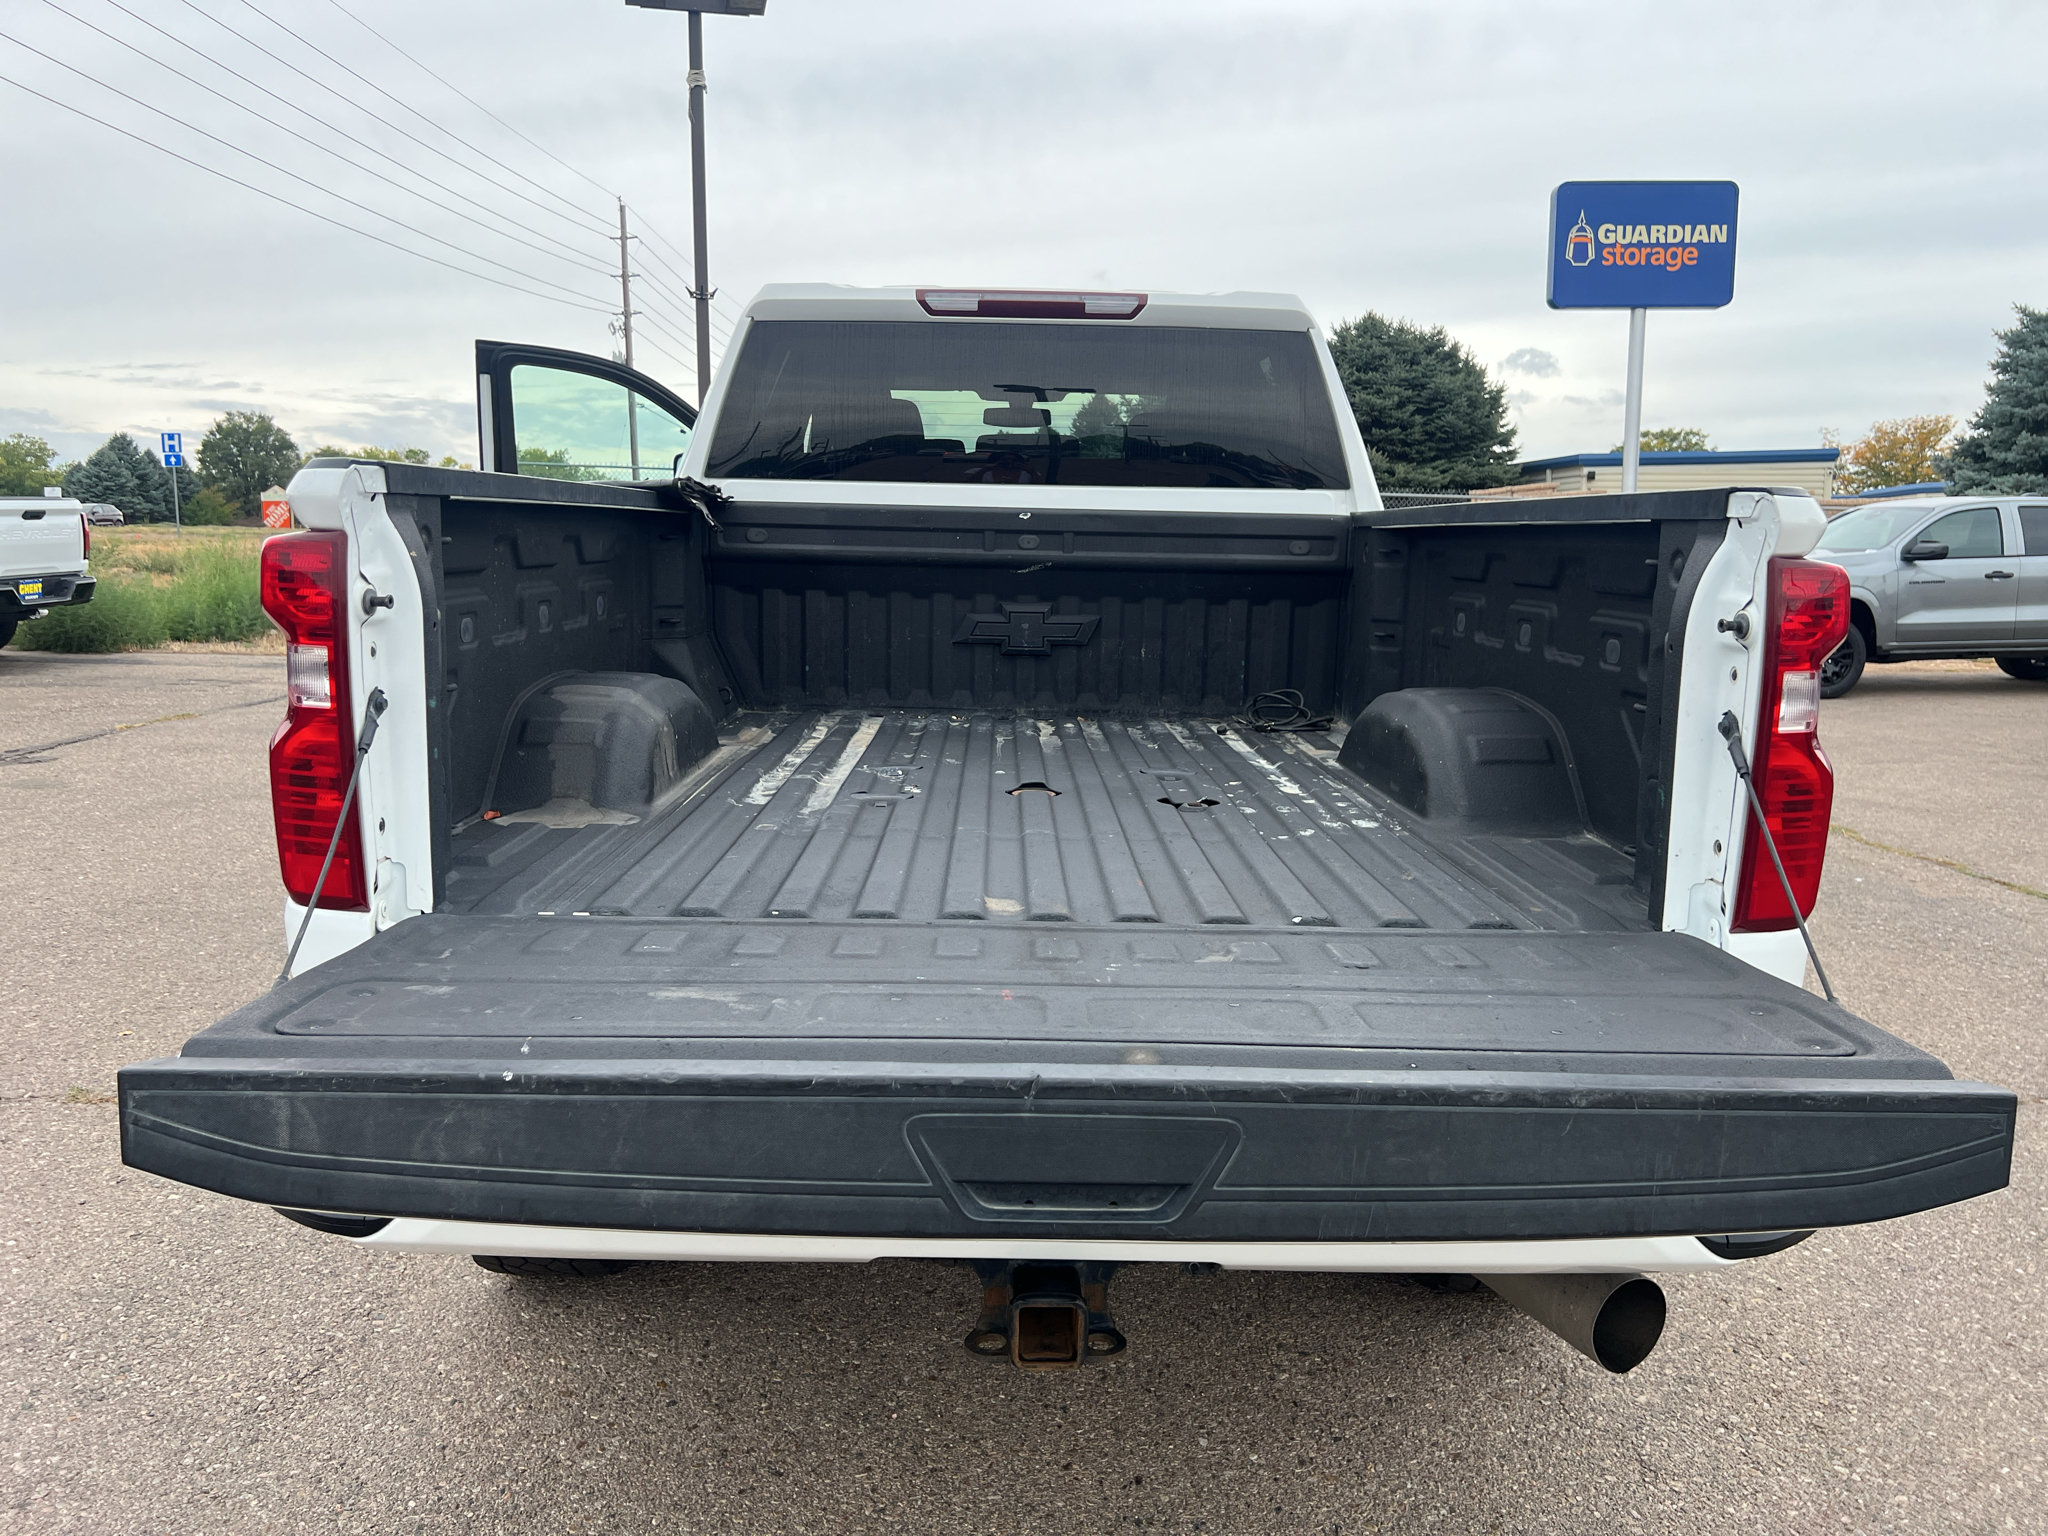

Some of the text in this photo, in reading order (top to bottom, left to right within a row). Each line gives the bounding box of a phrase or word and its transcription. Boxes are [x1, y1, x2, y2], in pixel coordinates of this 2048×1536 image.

[1597, 223, 1728, 244] GUARDIAN
[1602, 243, 1698, 272] storage
[163, 434, 180, 452] H
[263, 501, 290, 527] HOME
